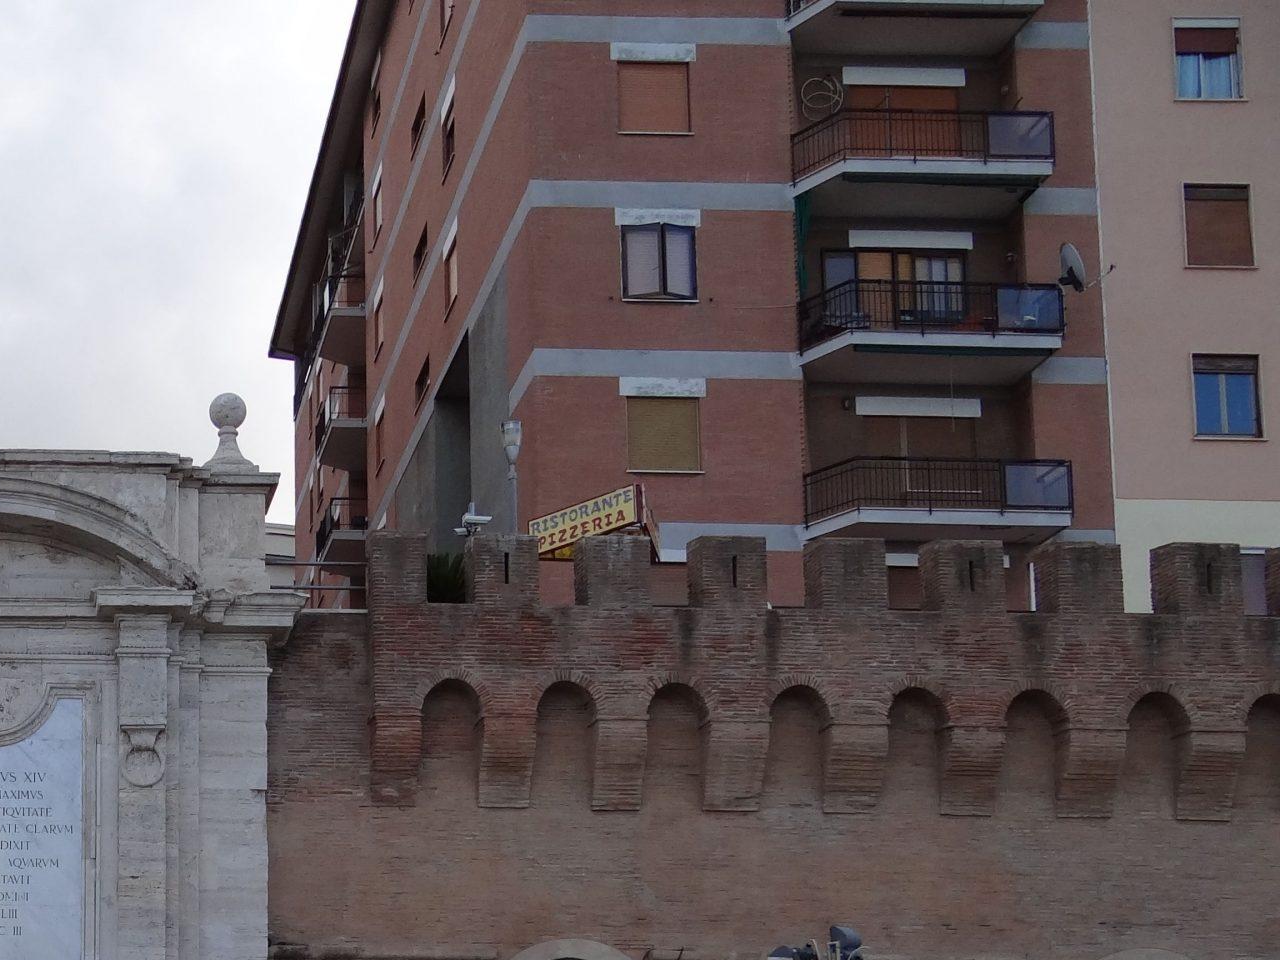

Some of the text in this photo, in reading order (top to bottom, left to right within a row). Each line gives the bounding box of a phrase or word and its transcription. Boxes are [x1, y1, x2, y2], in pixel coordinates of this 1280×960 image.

[530, 489, 633, 535] RISTORANTE
[538, 510, 626, 549] PIZZERIA
[23, 771, 47, 783] XIV
[25, 823, 74, 835] CLARVM
[0, 840, 30, 851] DIXIT
[8, 857, 60, 869] AQVARVM
[12, 925, 22, 936] III
